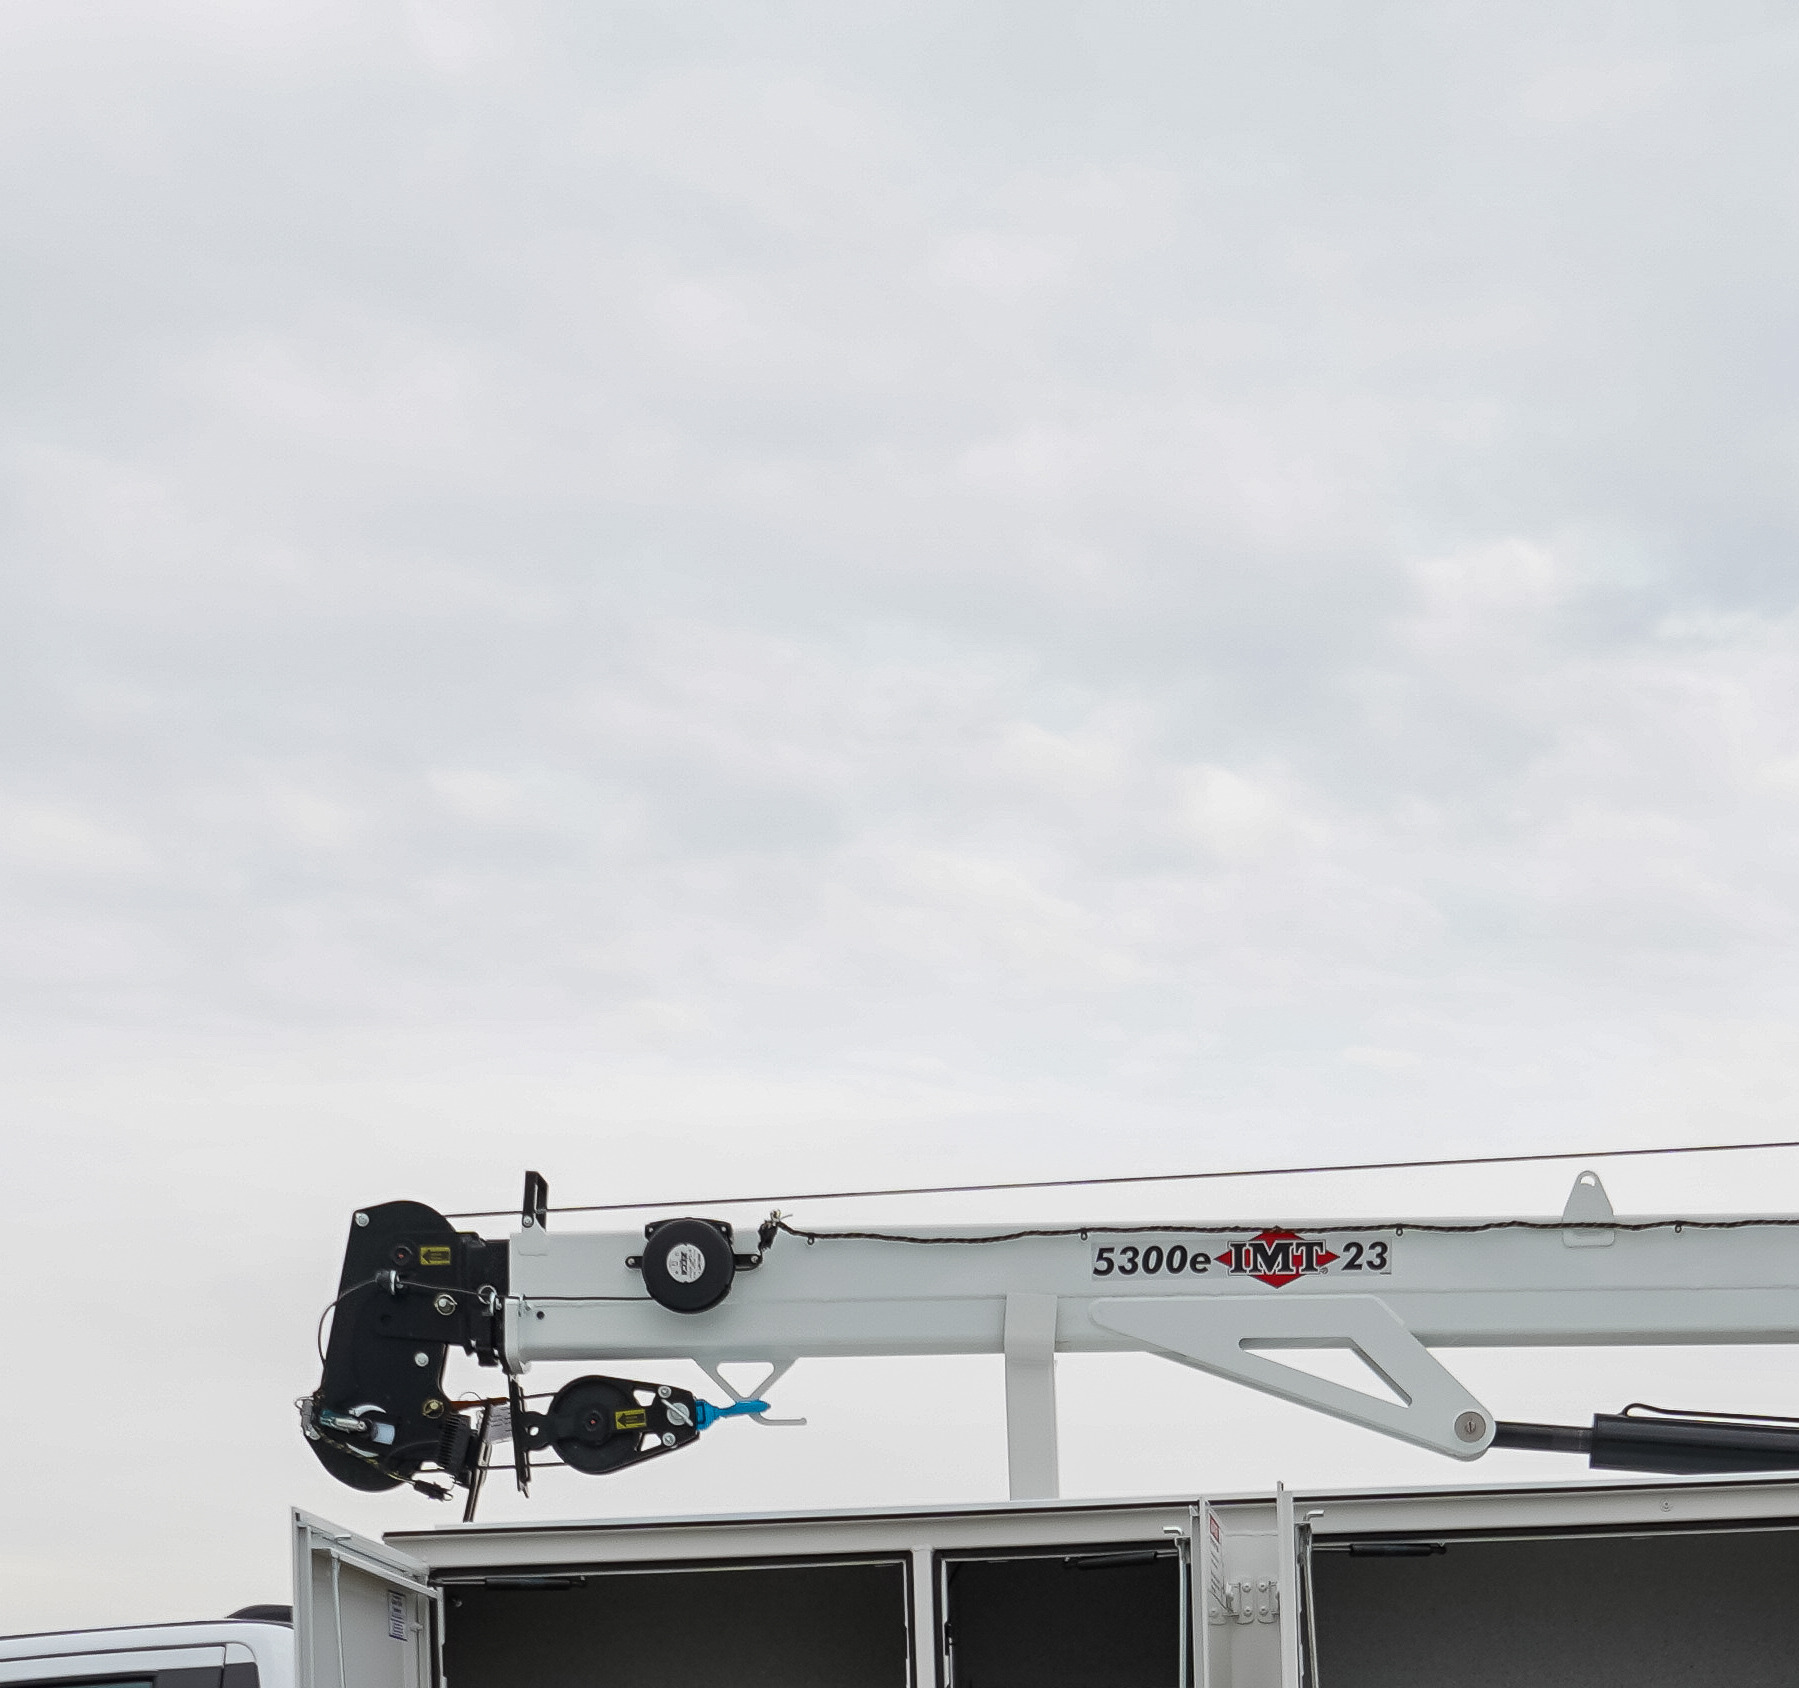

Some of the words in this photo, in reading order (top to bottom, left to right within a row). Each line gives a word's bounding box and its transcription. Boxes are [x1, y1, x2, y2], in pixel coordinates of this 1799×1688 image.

[1092, 1244, 1211, 1276] 5300e
[1228, 1240, 1327, 1276] IMT
[1341, 1241, 1389, 1271] 23
